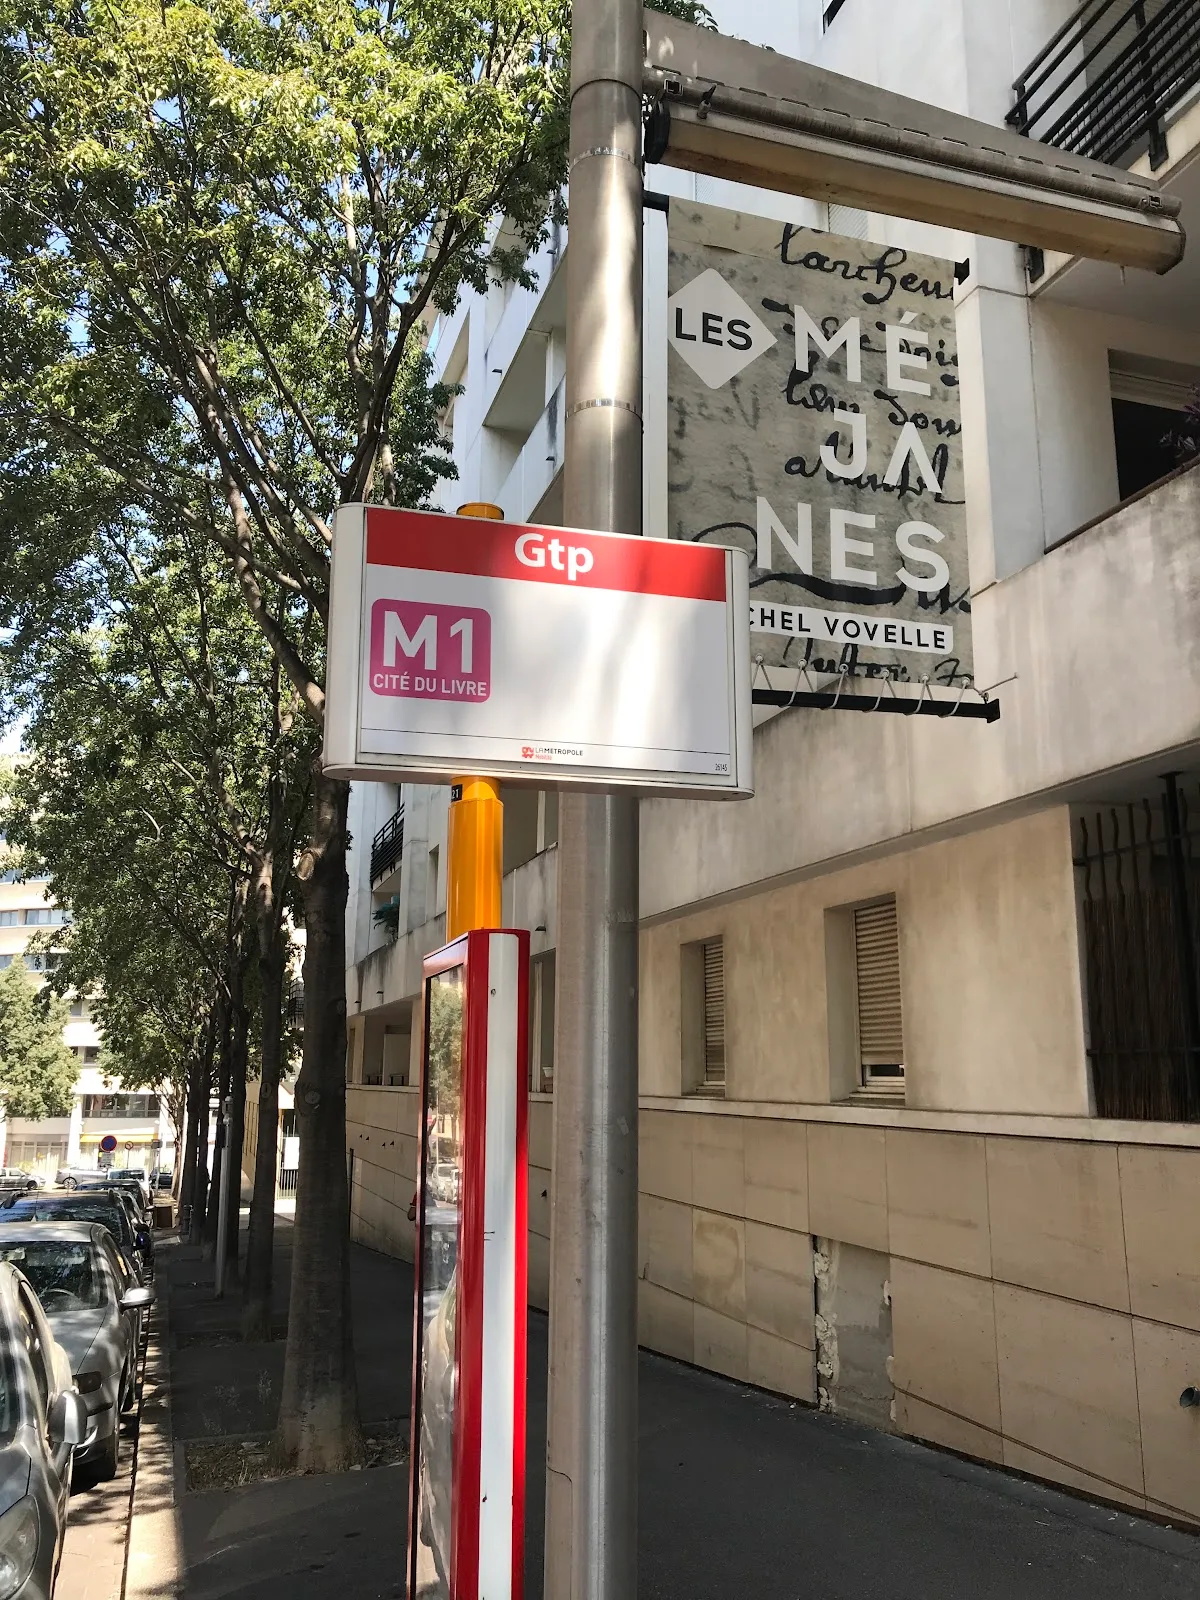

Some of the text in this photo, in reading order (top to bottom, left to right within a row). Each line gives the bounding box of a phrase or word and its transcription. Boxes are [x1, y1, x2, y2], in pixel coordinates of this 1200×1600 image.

[675, 307, 753, 351] LES
[794, 304, 932, 397] MÉ
[514, 533, 594, 581] Gtp
[756, 496, 950, 593] NES
[383, 610, 474, 674] M1
[823, 616, 946, 650] VOVELLE
[373, 671, 487, 697] CITÉ DU LIVRE
